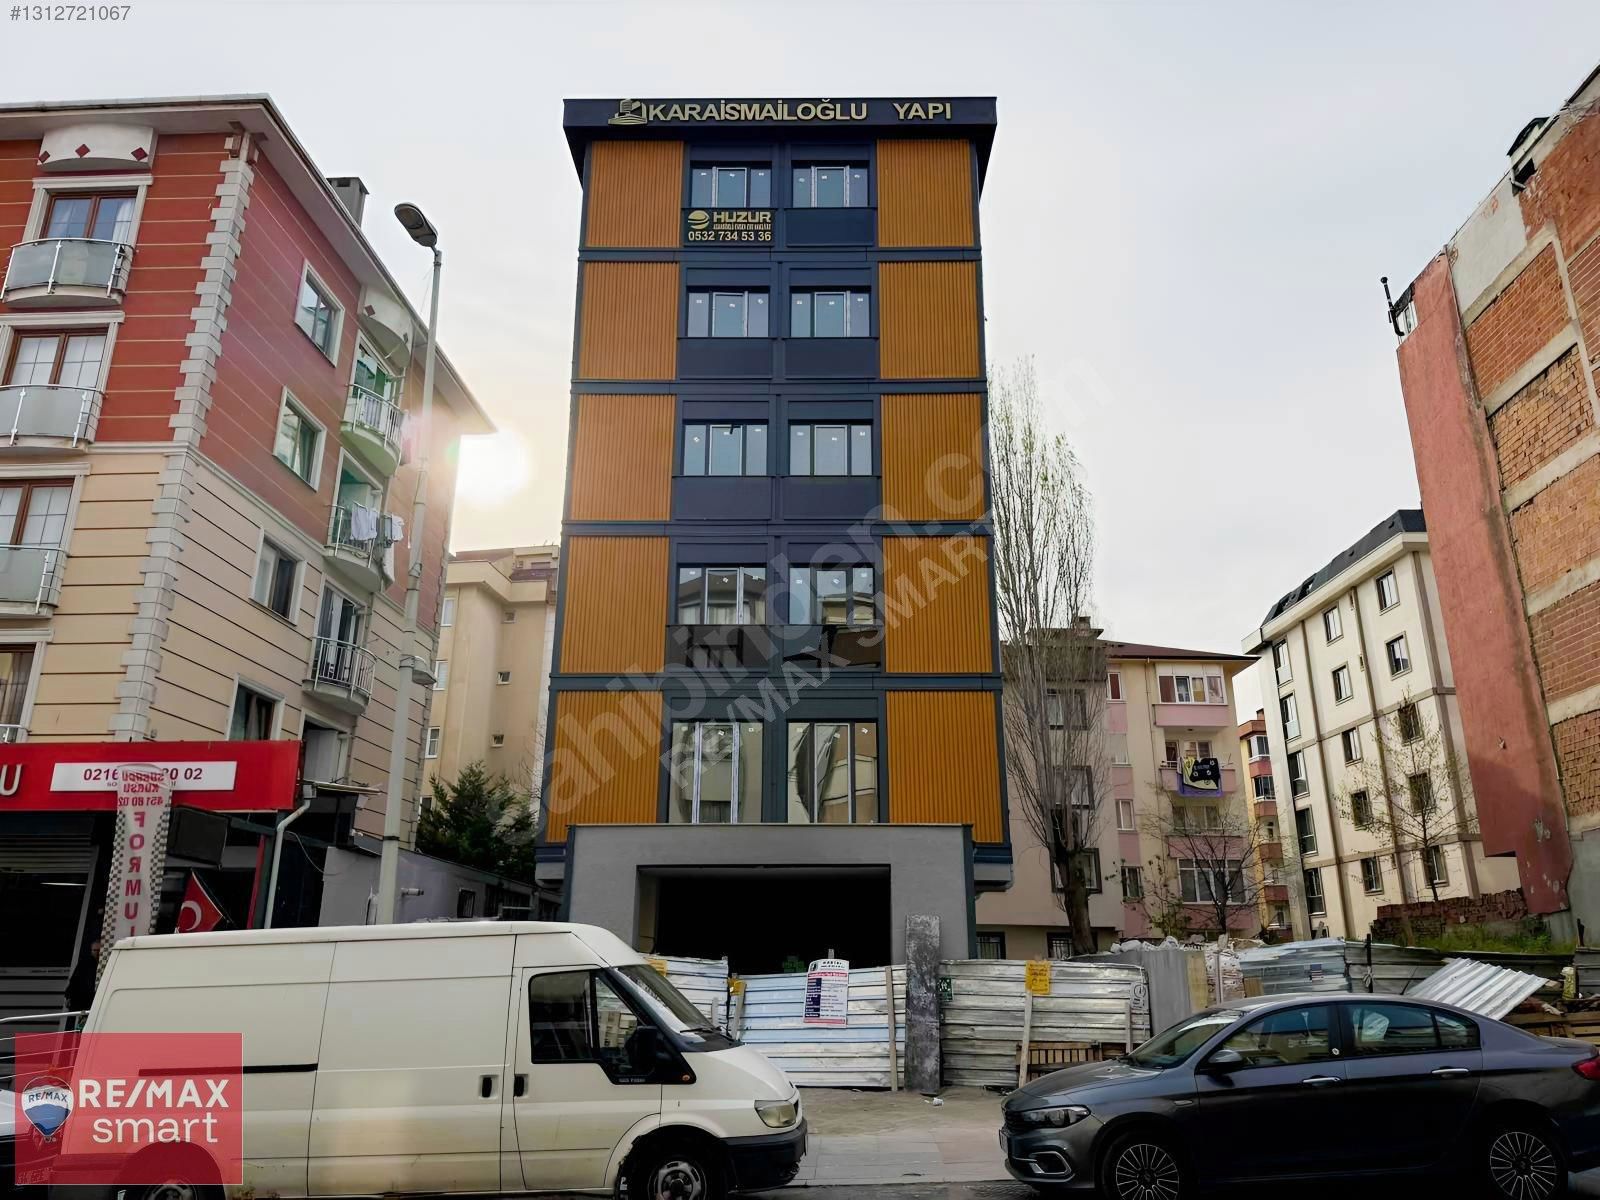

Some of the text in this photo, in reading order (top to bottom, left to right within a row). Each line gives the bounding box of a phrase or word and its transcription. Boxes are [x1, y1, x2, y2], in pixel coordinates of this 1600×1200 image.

[648, 98, 952, 121] KARAİSMAİLOĞLU YAPI
[712, 211, 772, 223] HUZUR
[688, 231, 772, 241] 0532 734 53 36
[183, 767, 204, 781] 02
